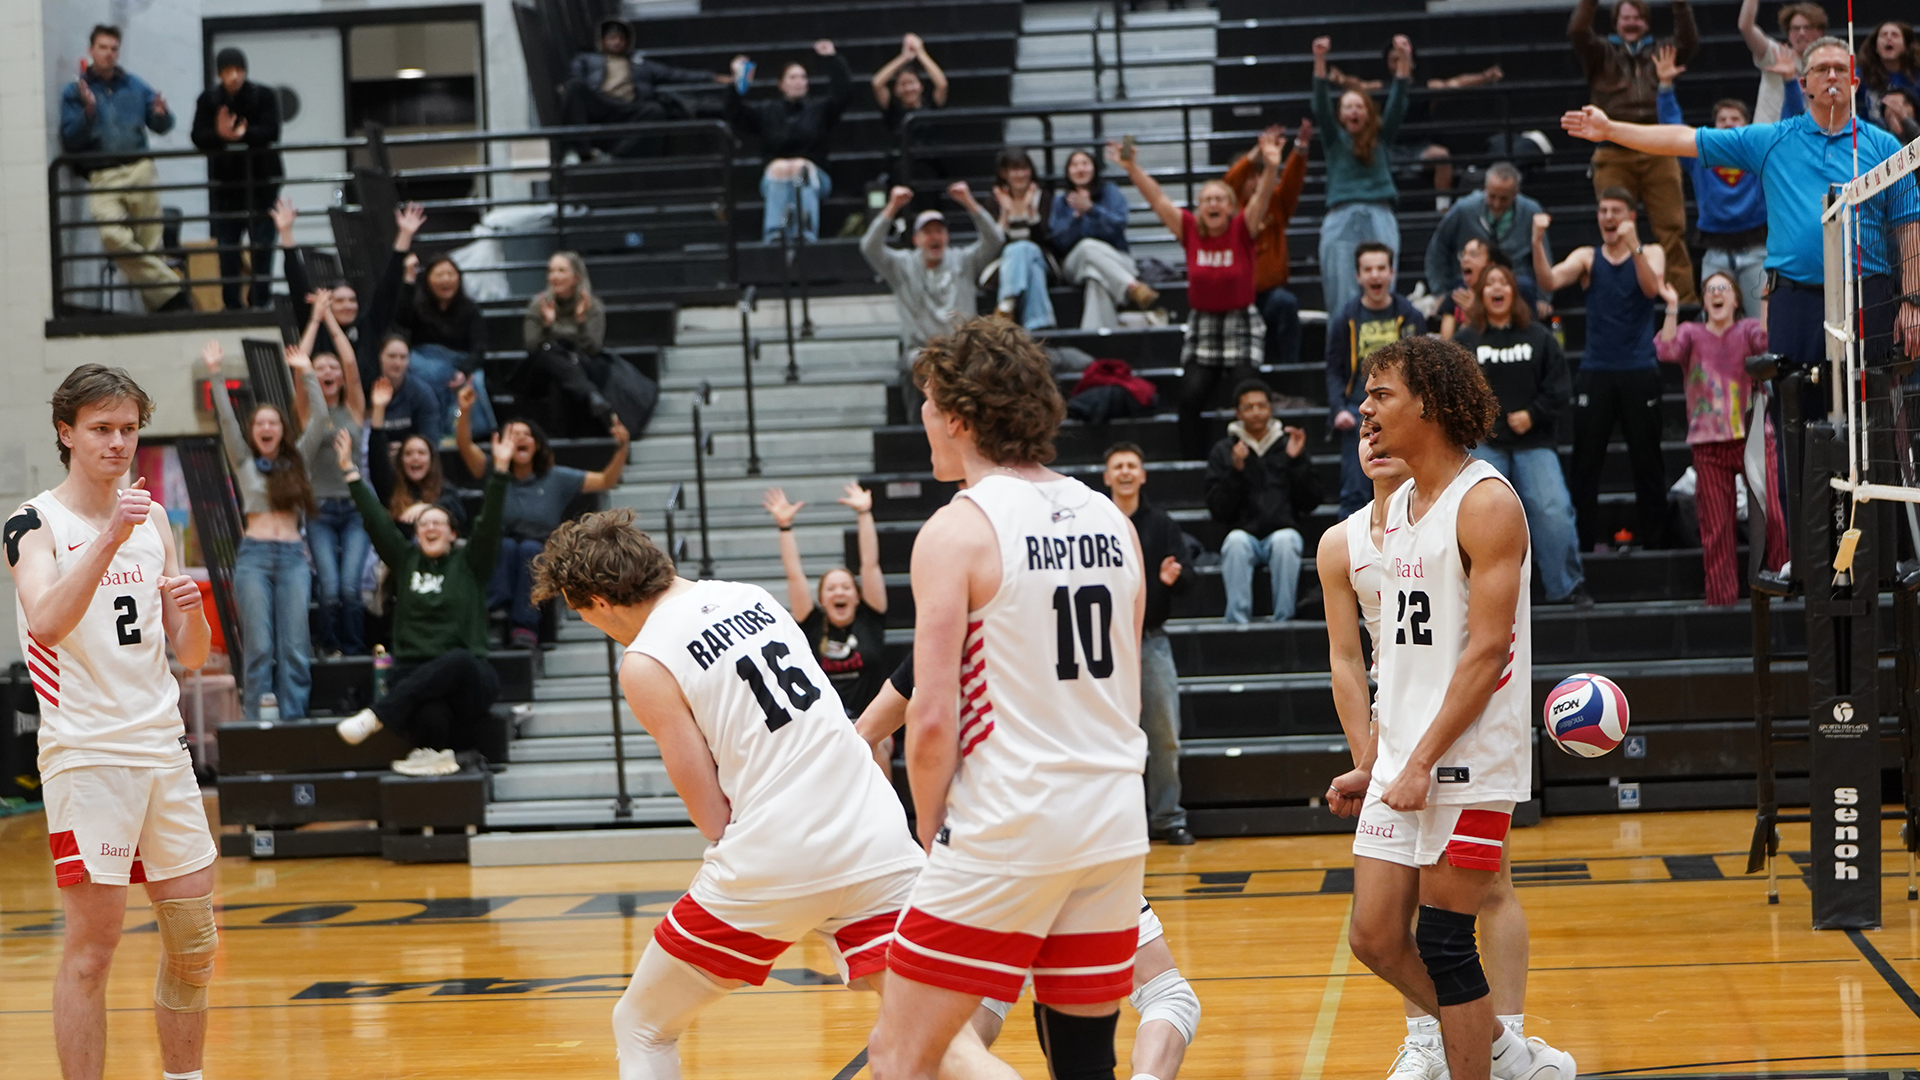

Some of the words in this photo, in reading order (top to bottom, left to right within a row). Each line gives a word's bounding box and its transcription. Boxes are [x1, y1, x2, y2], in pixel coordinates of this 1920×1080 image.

[1477, 343, 1533, 365] Pratt
[1026, 534, 1123, 570] RAPTORS
[100, 564, 144, 586] Bard
[1396, 557, 1424, 578] Bad
[114, 595, 142, 646] 2
[686, 602, 776, 671] RAPTORS
[1053, 585, 1114, 680] 10
[736, 640, 821, 733] 16
[1553, 698, 1579, 715] NCAA
[1459, 771, 1464, 779] L
[1359, 820, 1394, 839] Bard
[1834, 787, 1859, 880] Senoh
[100, 843, 130, 857] Bard
